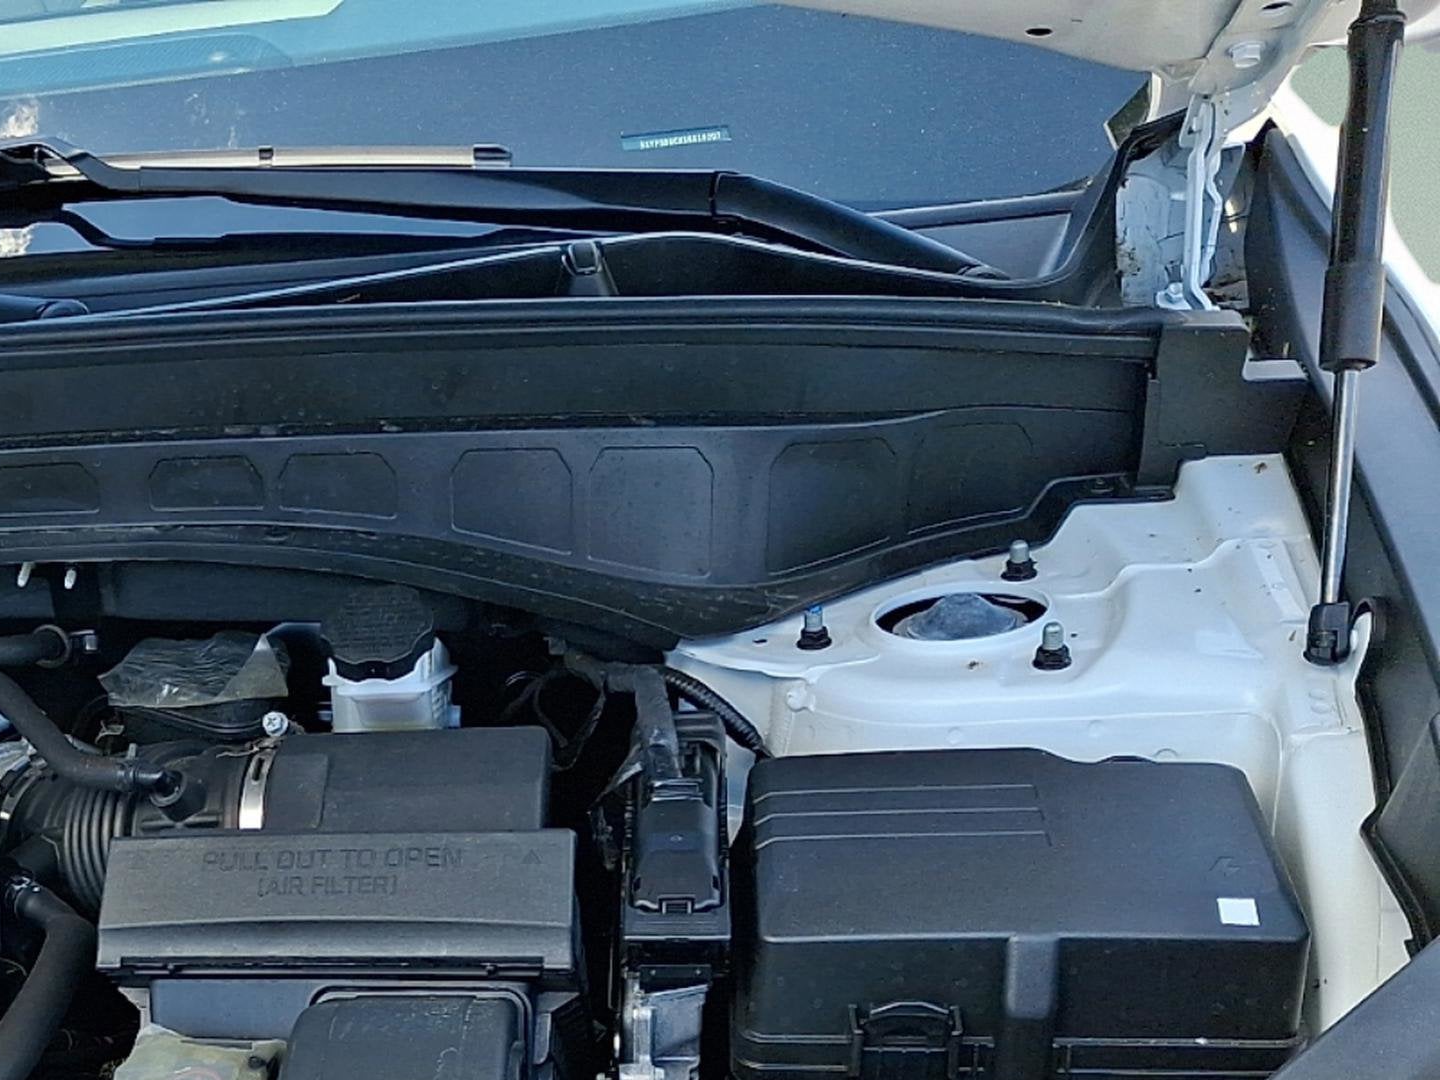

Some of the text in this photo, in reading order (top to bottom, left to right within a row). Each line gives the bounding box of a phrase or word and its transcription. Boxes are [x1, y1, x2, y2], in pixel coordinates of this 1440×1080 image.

[202, 846, 463, 872] PULL OUT TO OPEN
